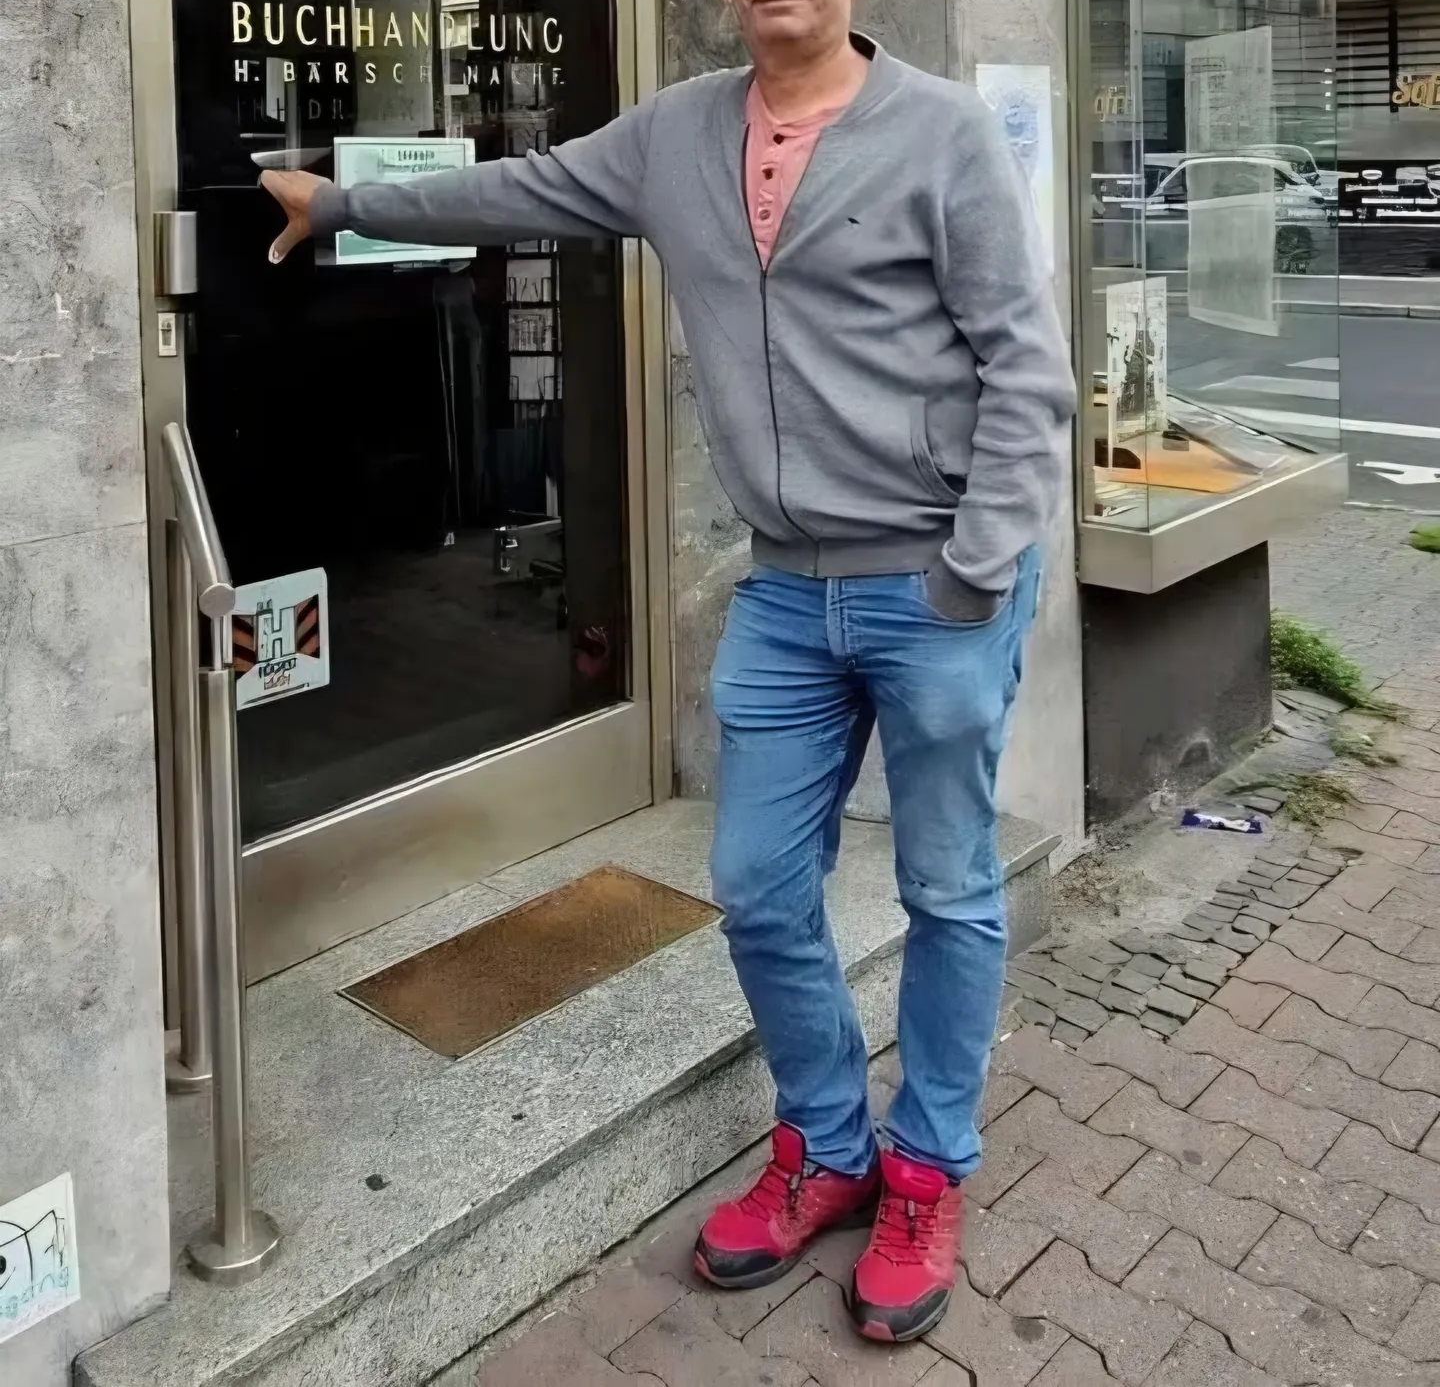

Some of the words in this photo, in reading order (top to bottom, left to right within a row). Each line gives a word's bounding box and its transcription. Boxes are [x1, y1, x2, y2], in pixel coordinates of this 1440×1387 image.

[231, 0, 563, 54] BUCHHANDLUNG
[234, 59, 260, 83] H.
[283, 61, 432, 85] BÄRSCH
